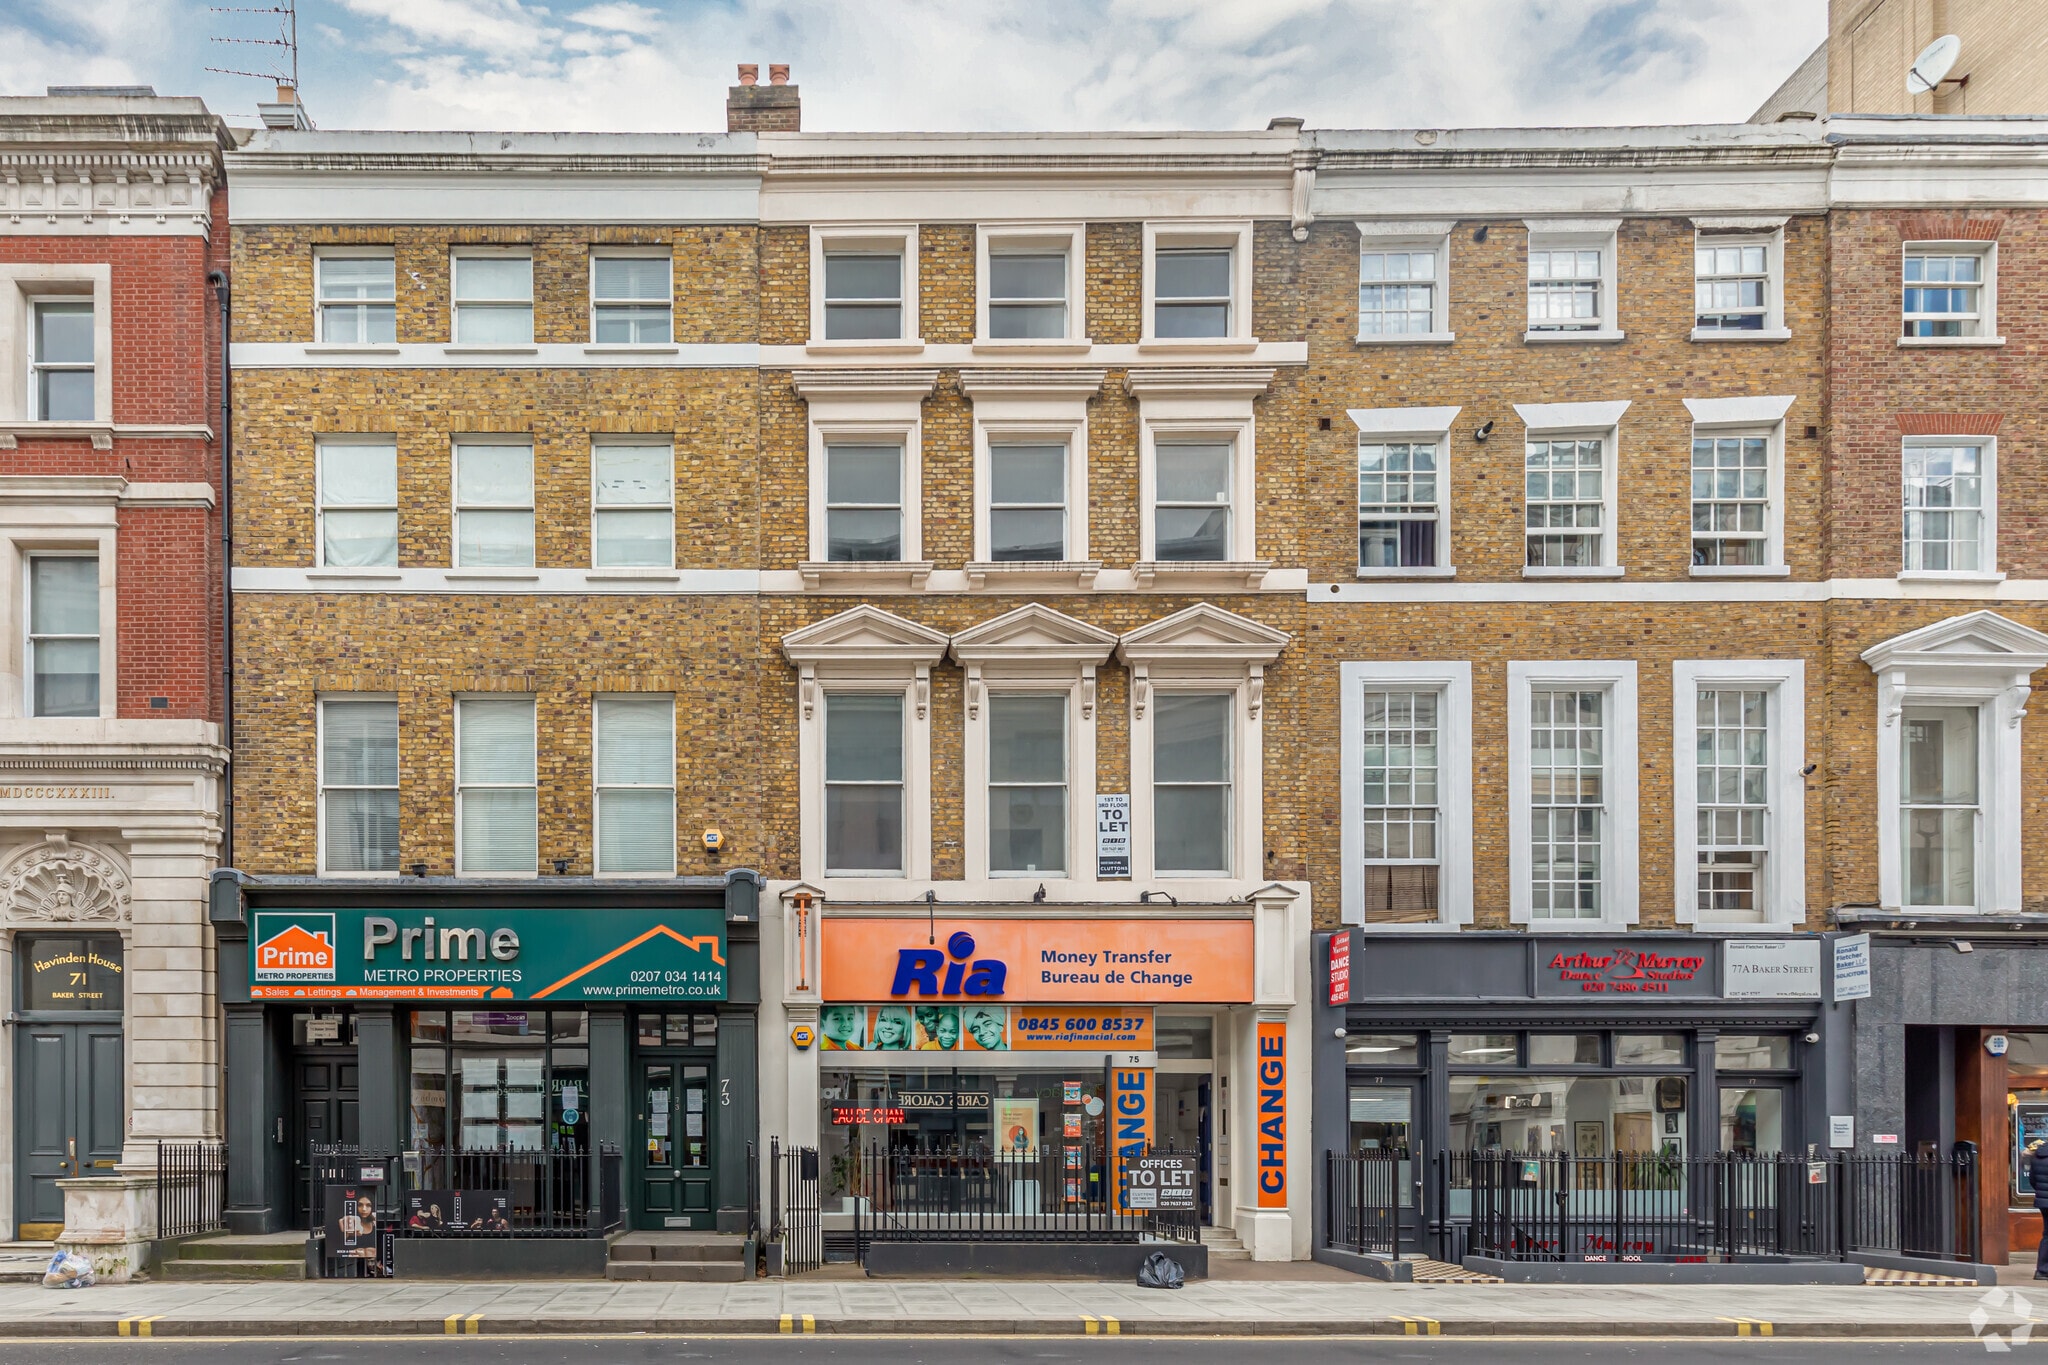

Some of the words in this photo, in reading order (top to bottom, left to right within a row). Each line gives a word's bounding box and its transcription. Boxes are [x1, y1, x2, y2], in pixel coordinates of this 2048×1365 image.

[1102, 809, 1123, 820] TO
[1099, 821, 1129, 832] LET
[363, 916, 521, 961] Prime
[263, 946, 328, 966] Prime
[1836, 946, 1858, 954] Ronald
[33, 952, 86, 973] Havinden
[88, 952, 123, 973] House
[890, 930, 1008, 996] Ria
[1040, 950, 1098, 966] Money
[1102, 950, 1172, 963] Transfer
[1331, 956, 1350, 971] DANCE
[1549, 952, 1612, 968] Arthur
[1637, 952, 1705, 972] Murray
[1836, 953, 1863, 961] Fletcher
[1732, 965, 1750, 974] 77A
[1752, 965, 1780, 974] BAKER
[1782, 965, 1814, 974] STREET
[1836, 961, 1855, 969] Baker
[69, 972, 87, 986] 71
[257, 972, 284, 980] METRO
[286, 972, 334, 980] PROPERTIES
[364, 969, 419, 982] METRO
[424, 969, 522, 982] PROPERTIES
[630, 971, 661, 982] 0207
[664, 971, 687, 982] 034
[692, 971, 722, 982] 1414
[1040, 970, 1100, 984] Bureau
[1104, 969, 1125, 984] de
[1130, 969, 1193, 987] Change
[1561, 970, 1602, 980] Dance
[1646, 970, 1694, 980] Studios
[1836, 970, 1868, 979] SOLICITORS
[265, 987, 290, 996] Sales
[307, 987, 341, 997] Lettings
[359, 987, 417, 997] Management
[418, 988, 425, 996] &
[427, 987, 479, 996] Investments
[583, 984, 721, 997] www.primemetro.co.uk
[1583, 982, 1606, 992] 020
[1608, 982, 1639, 992] 7486
[1641, 982, 1669, 992] 4511
[1018, 1018, 1059, 1031] 0845
[1065, 1018, 1097, 1031] 600
[1101, 1018, 1144, 1031] 8537
[1026, 1033, 1136, 1042] www.riafinancial.com
[1375, 1076, 1383, 1084] 77
[856, 1108, 871, 1124] DE
[1260, 1036, 1284, 1194] CHANGE
[1140, 1159, 1183, 1169] OFFICES
[1129, 1170, 1155, 1186] TO
[1160, 1170, 1194, 1186] LET
[1581, 1234, 1654, 1253] Muray
